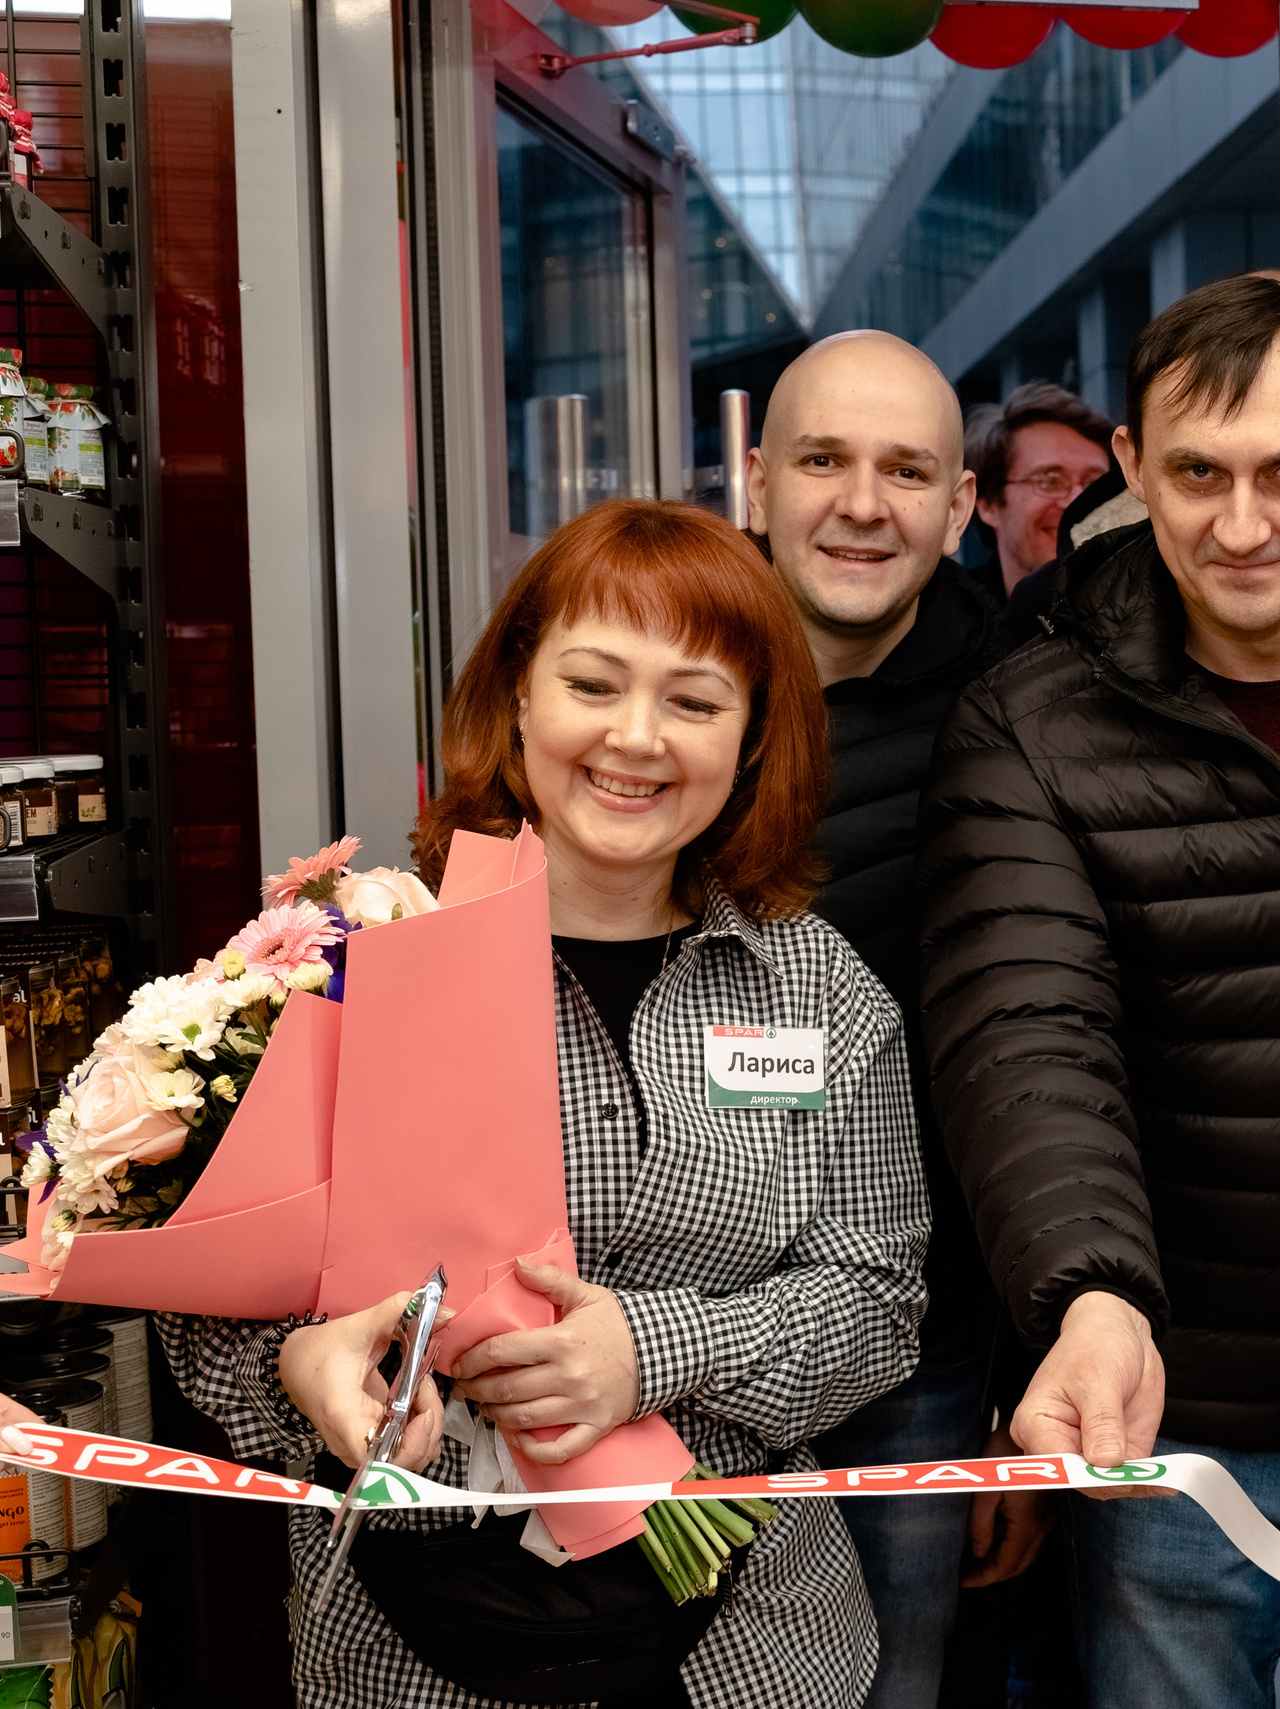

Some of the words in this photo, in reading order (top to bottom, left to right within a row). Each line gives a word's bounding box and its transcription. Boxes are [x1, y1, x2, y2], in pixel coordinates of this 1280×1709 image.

[725, 1028, 764, 1037] SPAR
[728, 1052, 815, 1078] Лариса
[750, 1095, 798, 1106] директор
[767, 1461, 1060, 1488] SPAR
